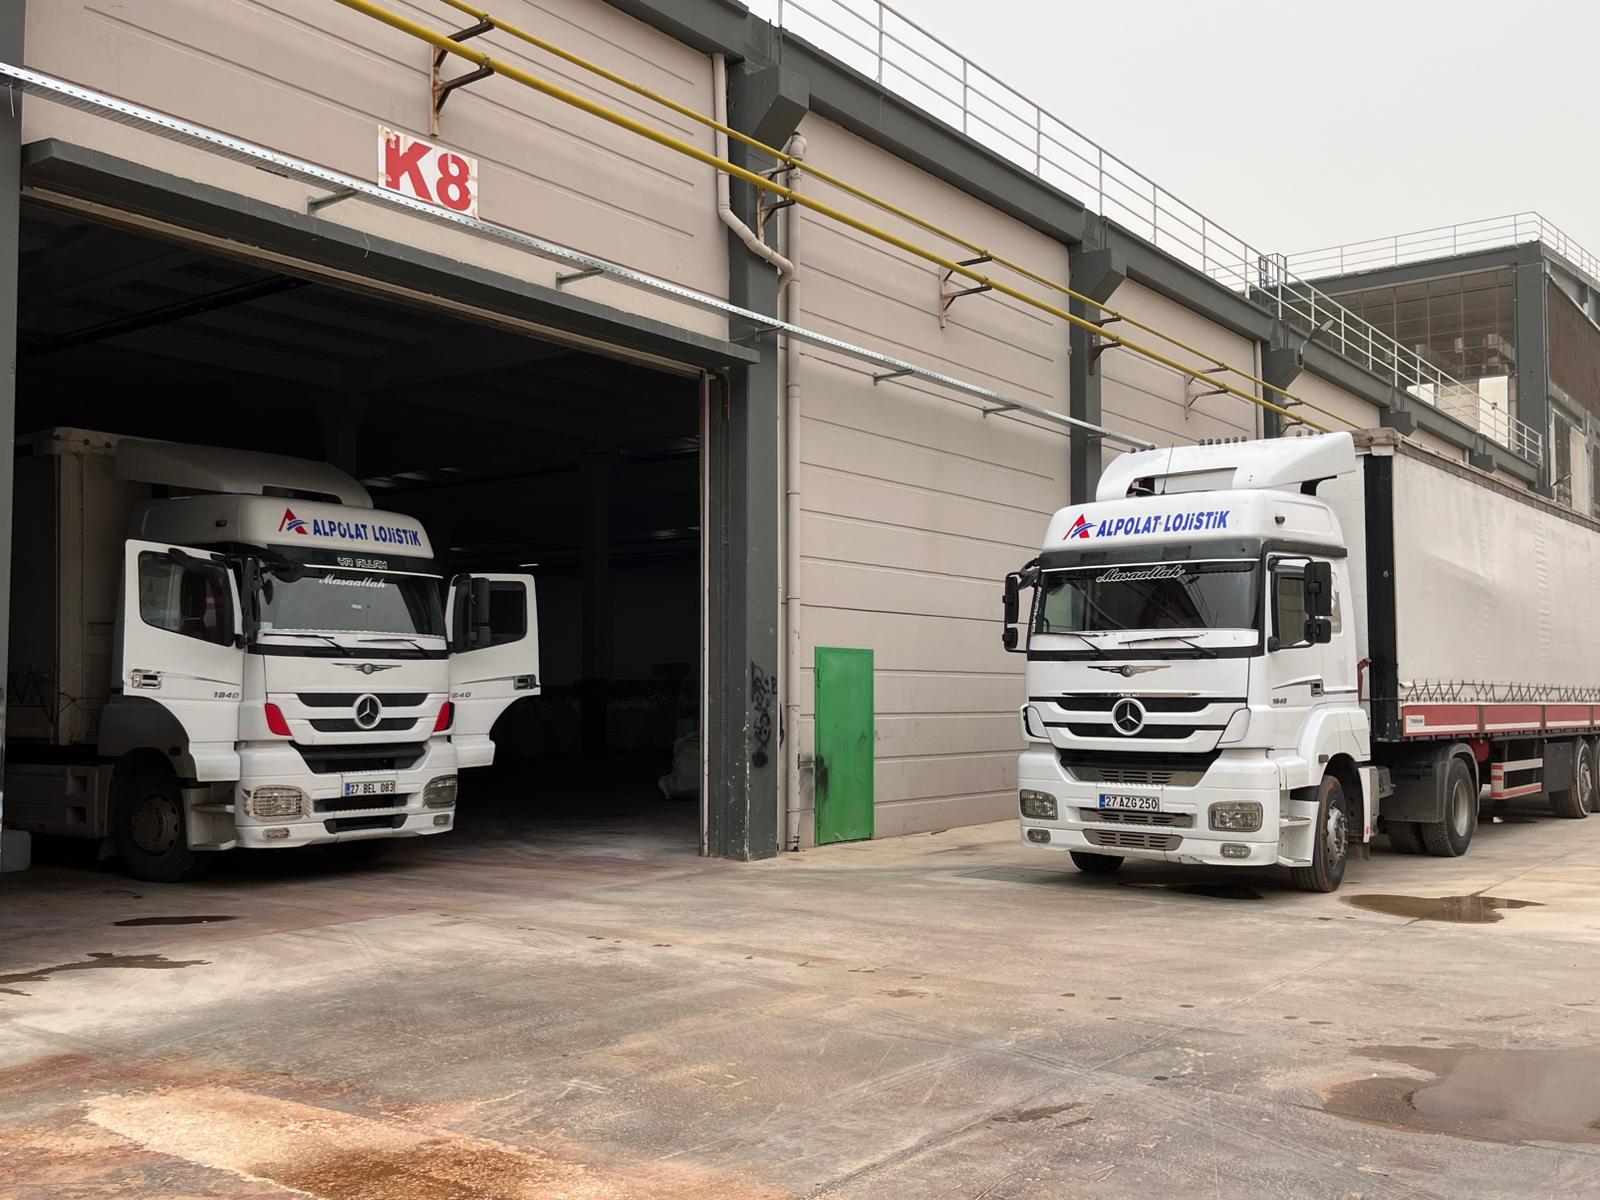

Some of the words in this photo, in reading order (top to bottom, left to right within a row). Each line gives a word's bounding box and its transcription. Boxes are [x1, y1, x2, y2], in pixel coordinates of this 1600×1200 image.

[384, 131, 472, 212] K8
[313, 518, 368, 540] ALPOLAT
[1095, 515, 1162, 538] ALPOLAT
[351, 783, 360, 795] 27
[363, 783, 377, 794] BEL
[380, 782, 393, 793] 083
[1105, 796, 1118, 807] 27
[1119, 796, 1138, 808] AZG
[1138, 798, 1158, 810] 250
